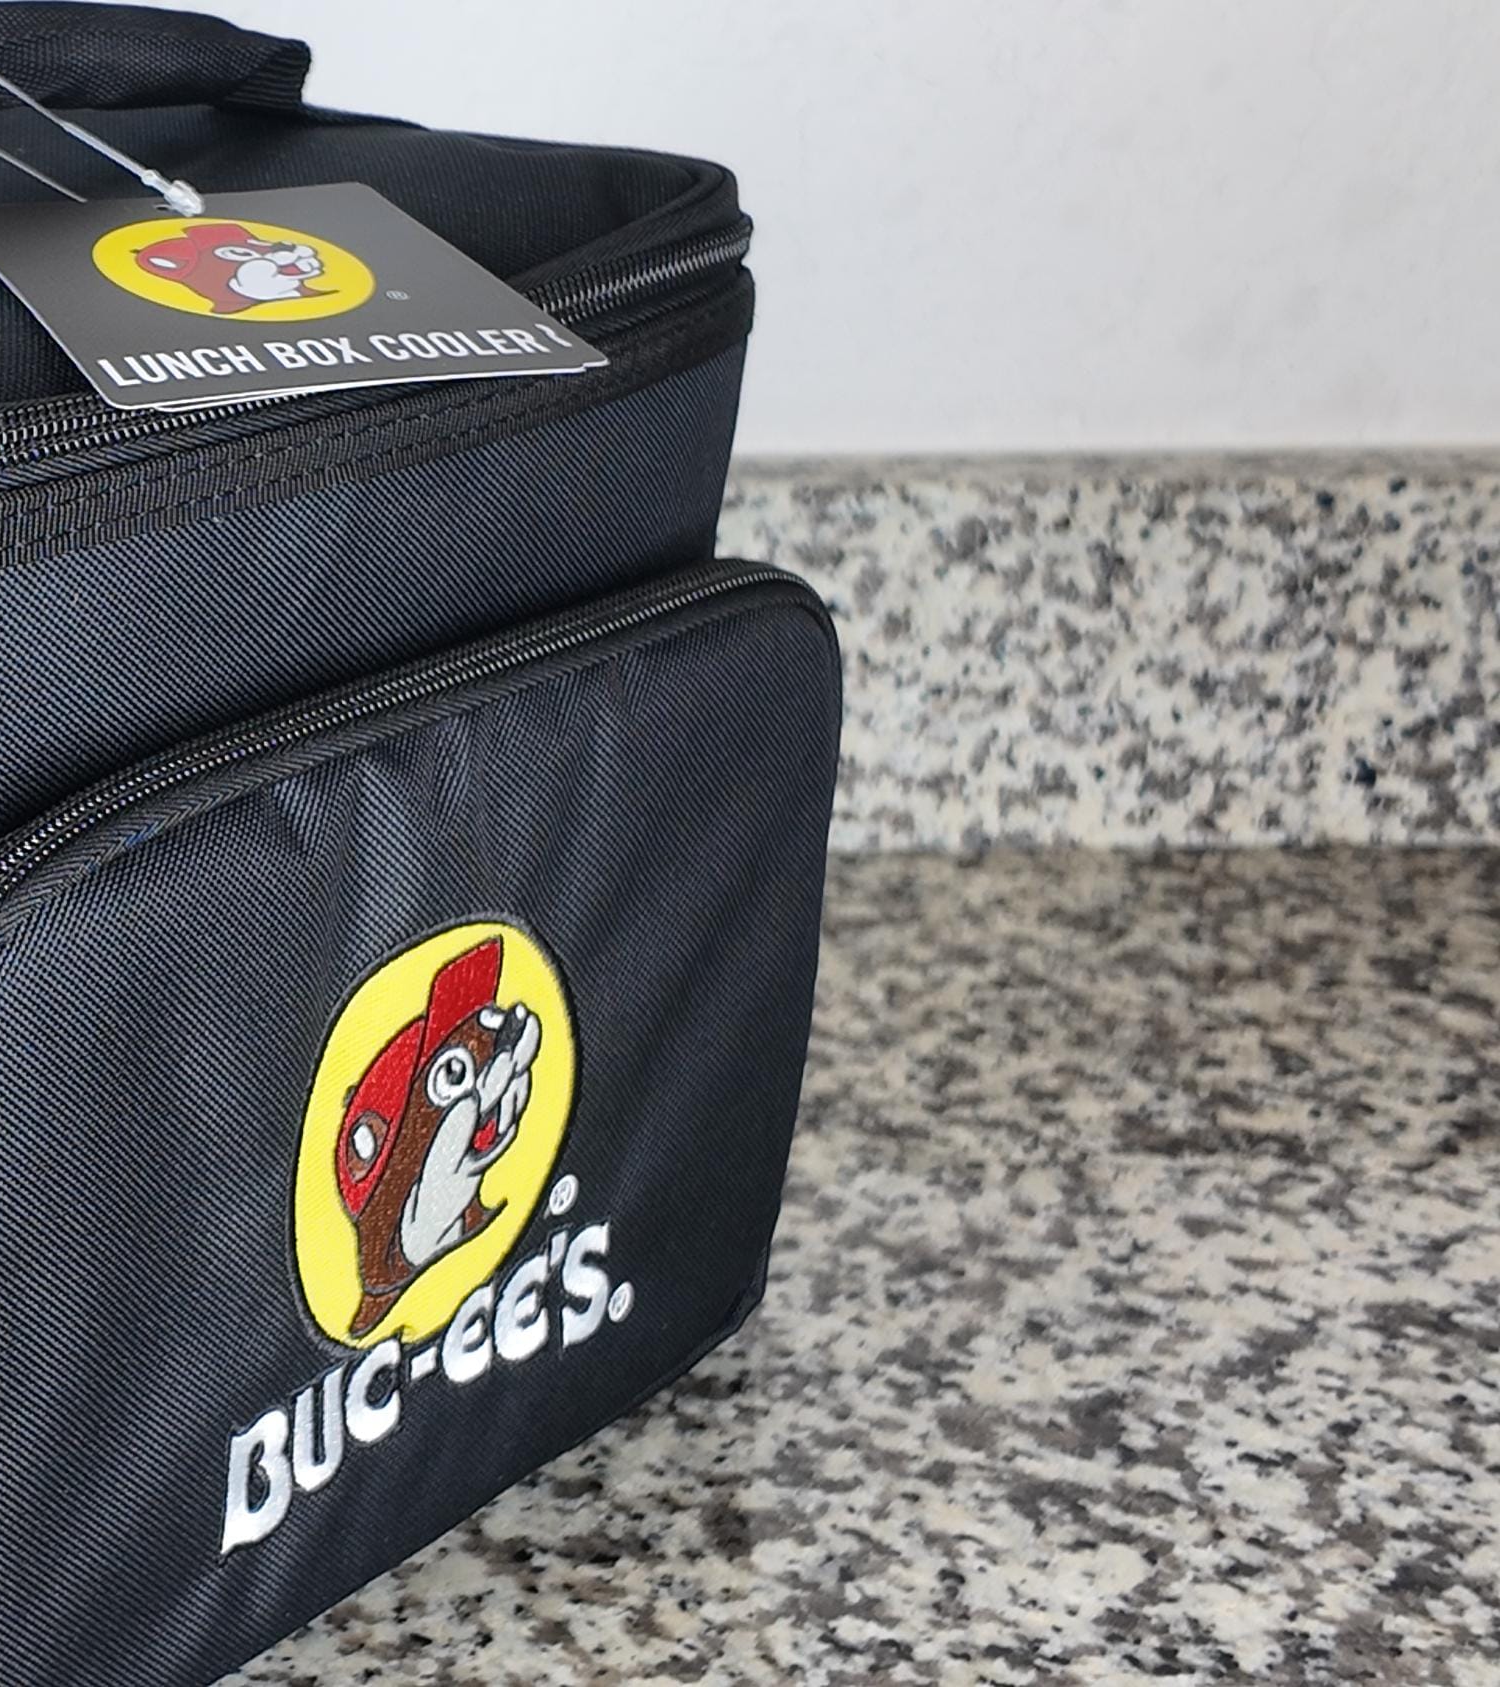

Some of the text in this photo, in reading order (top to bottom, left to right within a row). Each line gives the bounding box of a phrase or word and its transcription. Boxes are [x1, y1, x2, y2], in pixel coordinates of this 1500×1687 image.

[97, 343, 268, 387] LUNCH
[262, 336, 373, 369] BOX
[368, 328, 552, 361] COOLER
